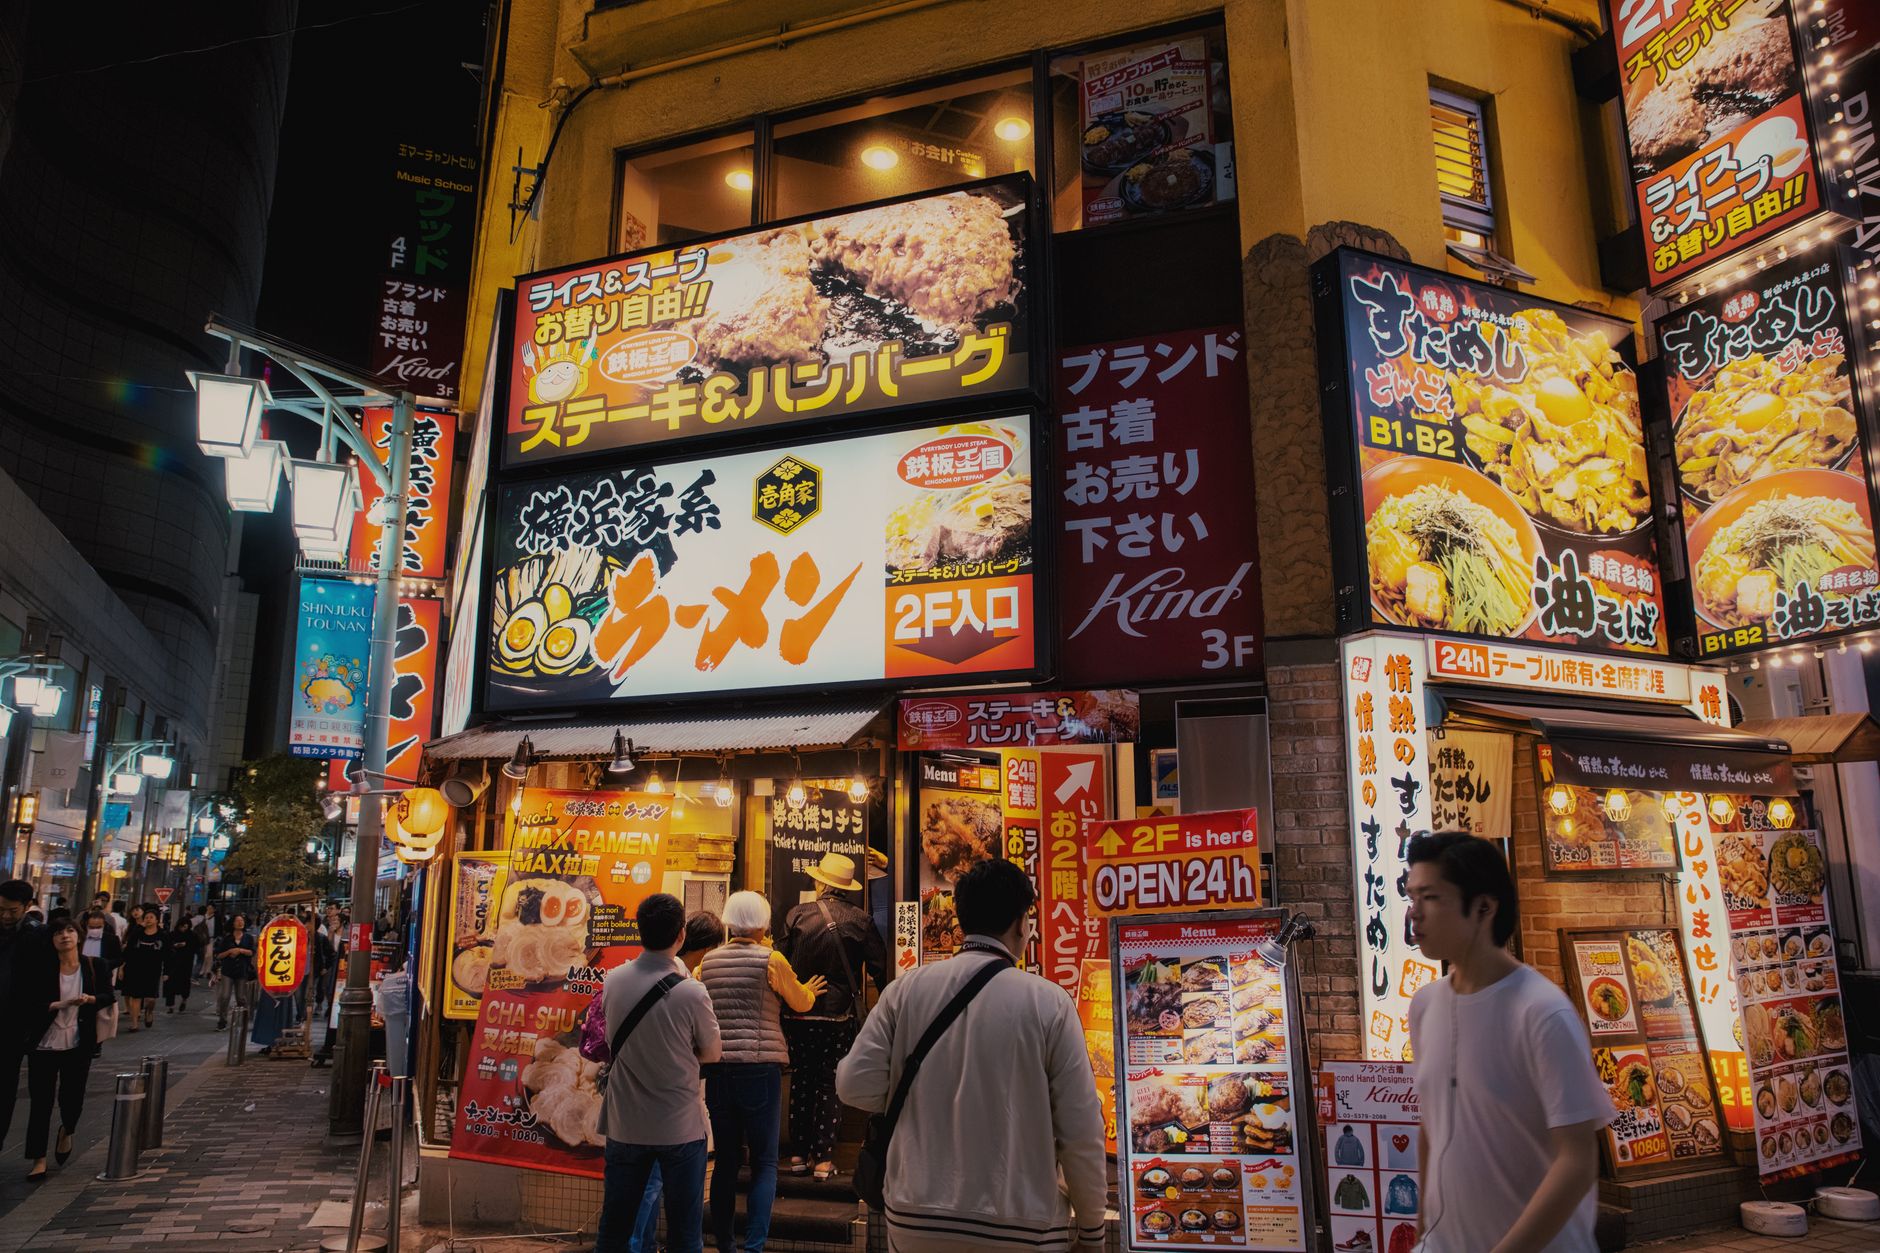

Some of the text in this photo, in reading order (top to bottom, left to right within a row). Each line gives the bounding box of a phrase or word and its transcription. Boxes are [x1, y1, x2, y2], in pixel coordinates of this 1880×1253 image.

[911, 142, 956, 164] お会計
[396, 170, 473, 193] Music School
[1646, 142, 1740, 214] ライス
[384, 280, 446, 303] ブランド
[528, 249, 709, 312] ライス&スープ
[383, 298, 416, 317] 古着
[534, 281, 714, 346] お替り自由!!
[381, 314, 427, 336] お売り
[380, 331, 428, 352] 下さい
[376, 355, 455, 382] Kind
[1062, 331, 1242, 396] ブランド
[436, 383, 454, 397] 3F
[520, 326, 1007, 453] ステーキ&ハンバーグ
[1062, 397, 1156, 452] 古着
[920, 443, 953, 453] EVERYBODY
[954, 441, 969, 449] LOVE
[903, 445, 1005, 480] 鉄板王国
[924, 477, 953, 485] KINGDOM
[1063, 448, 1200, 506] お売り
[757, 479, 816, 509] 壱角家
[516, 468, 723, 555] 横浜家系
[1065, 511, 1209, 564] 下さい
[890, 557, 1023, 585] ステーキ&ハンバーグ
[1588, 552, 1654, 595] 東京名物
[1818, 568, 1879, 593] 東京名物
[301, 601, 371, 618] SHINJUKU
[1067, 561, 1254, 640] Kind
[1532, 548, 1661, 645] 油そば
[306, 617, 366, 632] TOUNAN
[594, 549, 863, 681] ラーメン
[893, 584, 1021, 641] 2F入口
[1201, 628, 1254, 671] 3F
[1440, 645, 1488, 677] 24h
[908, 697, 1077, 725] 鉄板王国 ステーキ&
[294, 733, 362, 746] 路上喫煙禁止
[967, 720, 1078, 744] ハンバーグ
[1437, 747, 1475, 771] 情熱の
[923, 764, 958, 784] Menu
[1429, 771, 1491, 804] ためし
[1008, 783, 1037, 808] 営業
[563, 800, 670, 822] 横浜家系 ラーメン
[520, 826, 573, 851] MAX
[573, 829, 660, 856] RAMEN
[798, 837, 831, 853] vending
[1132, 823, 1255, 854] 2F is here
[1354, 691, 1390, 1003] 情熱のすためし
[513, 851, 602, 878] MAX拉面
[1095, 861, 1181, 908] OPEN
[606, 906, 619, 914] nori
[1050, 810, 1081, 1000] お2階へどう
[1180, 927, 1217, 938] Menu
[269, 929, 293, 983] もんじゃ
[567, 966, 605, 981] MAX
[1356, 1074, 1377, 1084] Hand
[1377, 1075, 1415, 1085] Designers
[1360, 1064, 1405, 1075] ブランド古着
[1340, 1089, 1350, 1099] 3F
[464, 1099, 539, 1129] チャーシューメン
[1135, 1161, 1152, 1170] カレー
